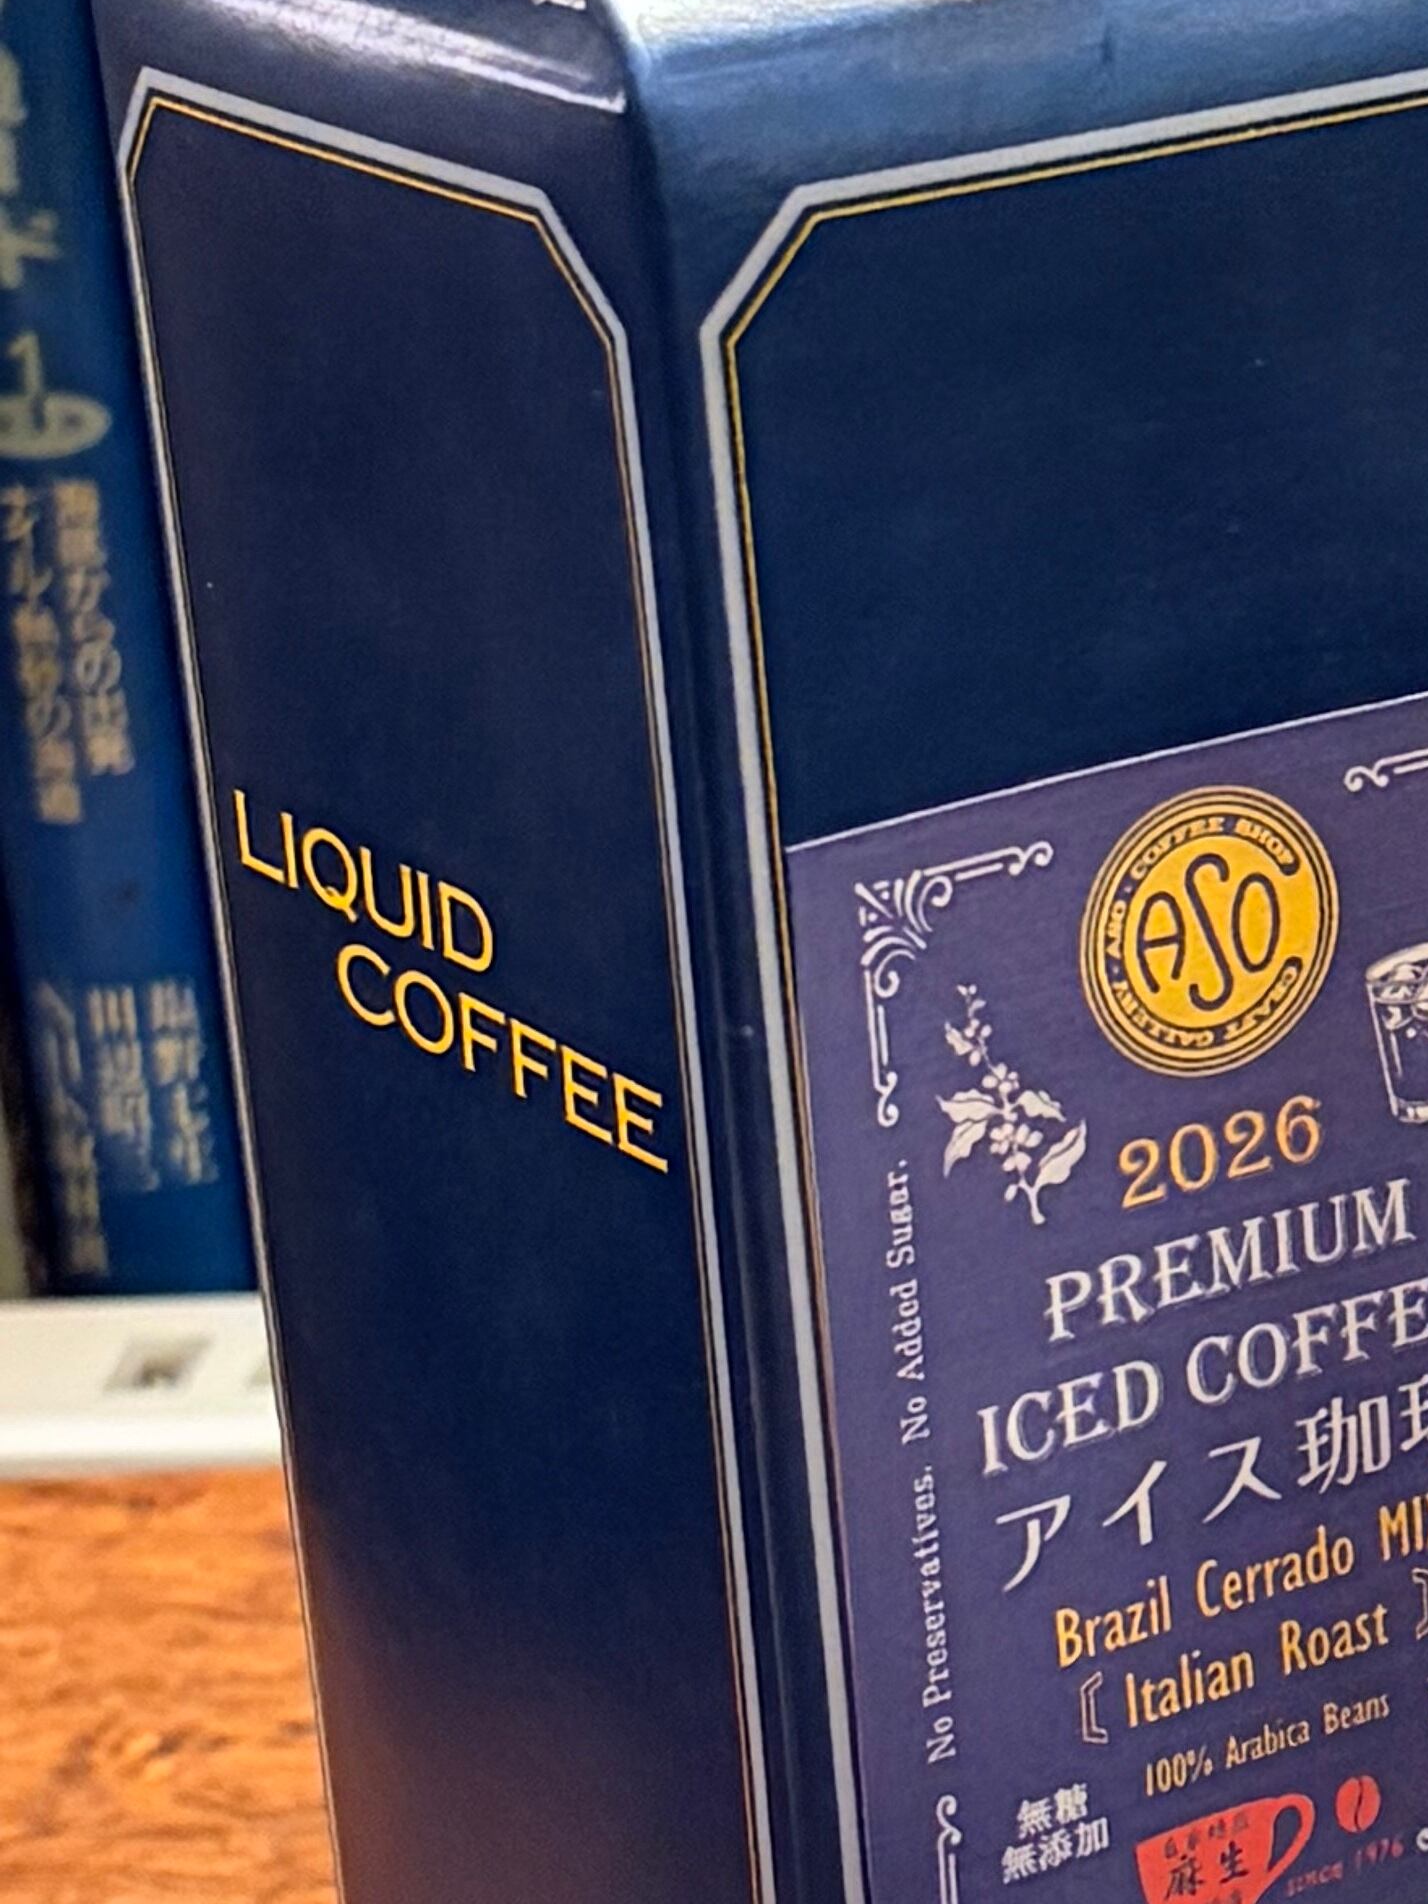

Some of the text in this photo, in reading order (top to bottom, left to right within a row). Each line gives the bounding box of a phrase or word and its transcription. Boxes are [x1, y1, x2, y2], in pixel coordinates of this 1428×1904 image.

[233, 788, 495, 974] LIQUID
[1135, 851, 1281, 1012] ASO
[336, 943, 669, 1175] COFFEE
[1118, 1095, 1324, 1210] 2026
[1043, 1177, 1417, 1344] PREMIUM
[885, 1159, 957, 1765] No Preservatives. No Added Sugar.
[977, 1359, 1166, 1478] ICED
[1055, 1581, 1173, 1670] Brazil
[1197, 1524, 1355, 1618] Cerrado
[1125, 1602, 1391, 1730] Italian Roast
[1144, 1693, 1391, 1798] 100% Arabica Beans
[1000, 1816, 1110, 1885] 無添加
[1015, 1782, 1089, 1840] 無糖
[1163, 1839, 1250, 1902] 麻生
